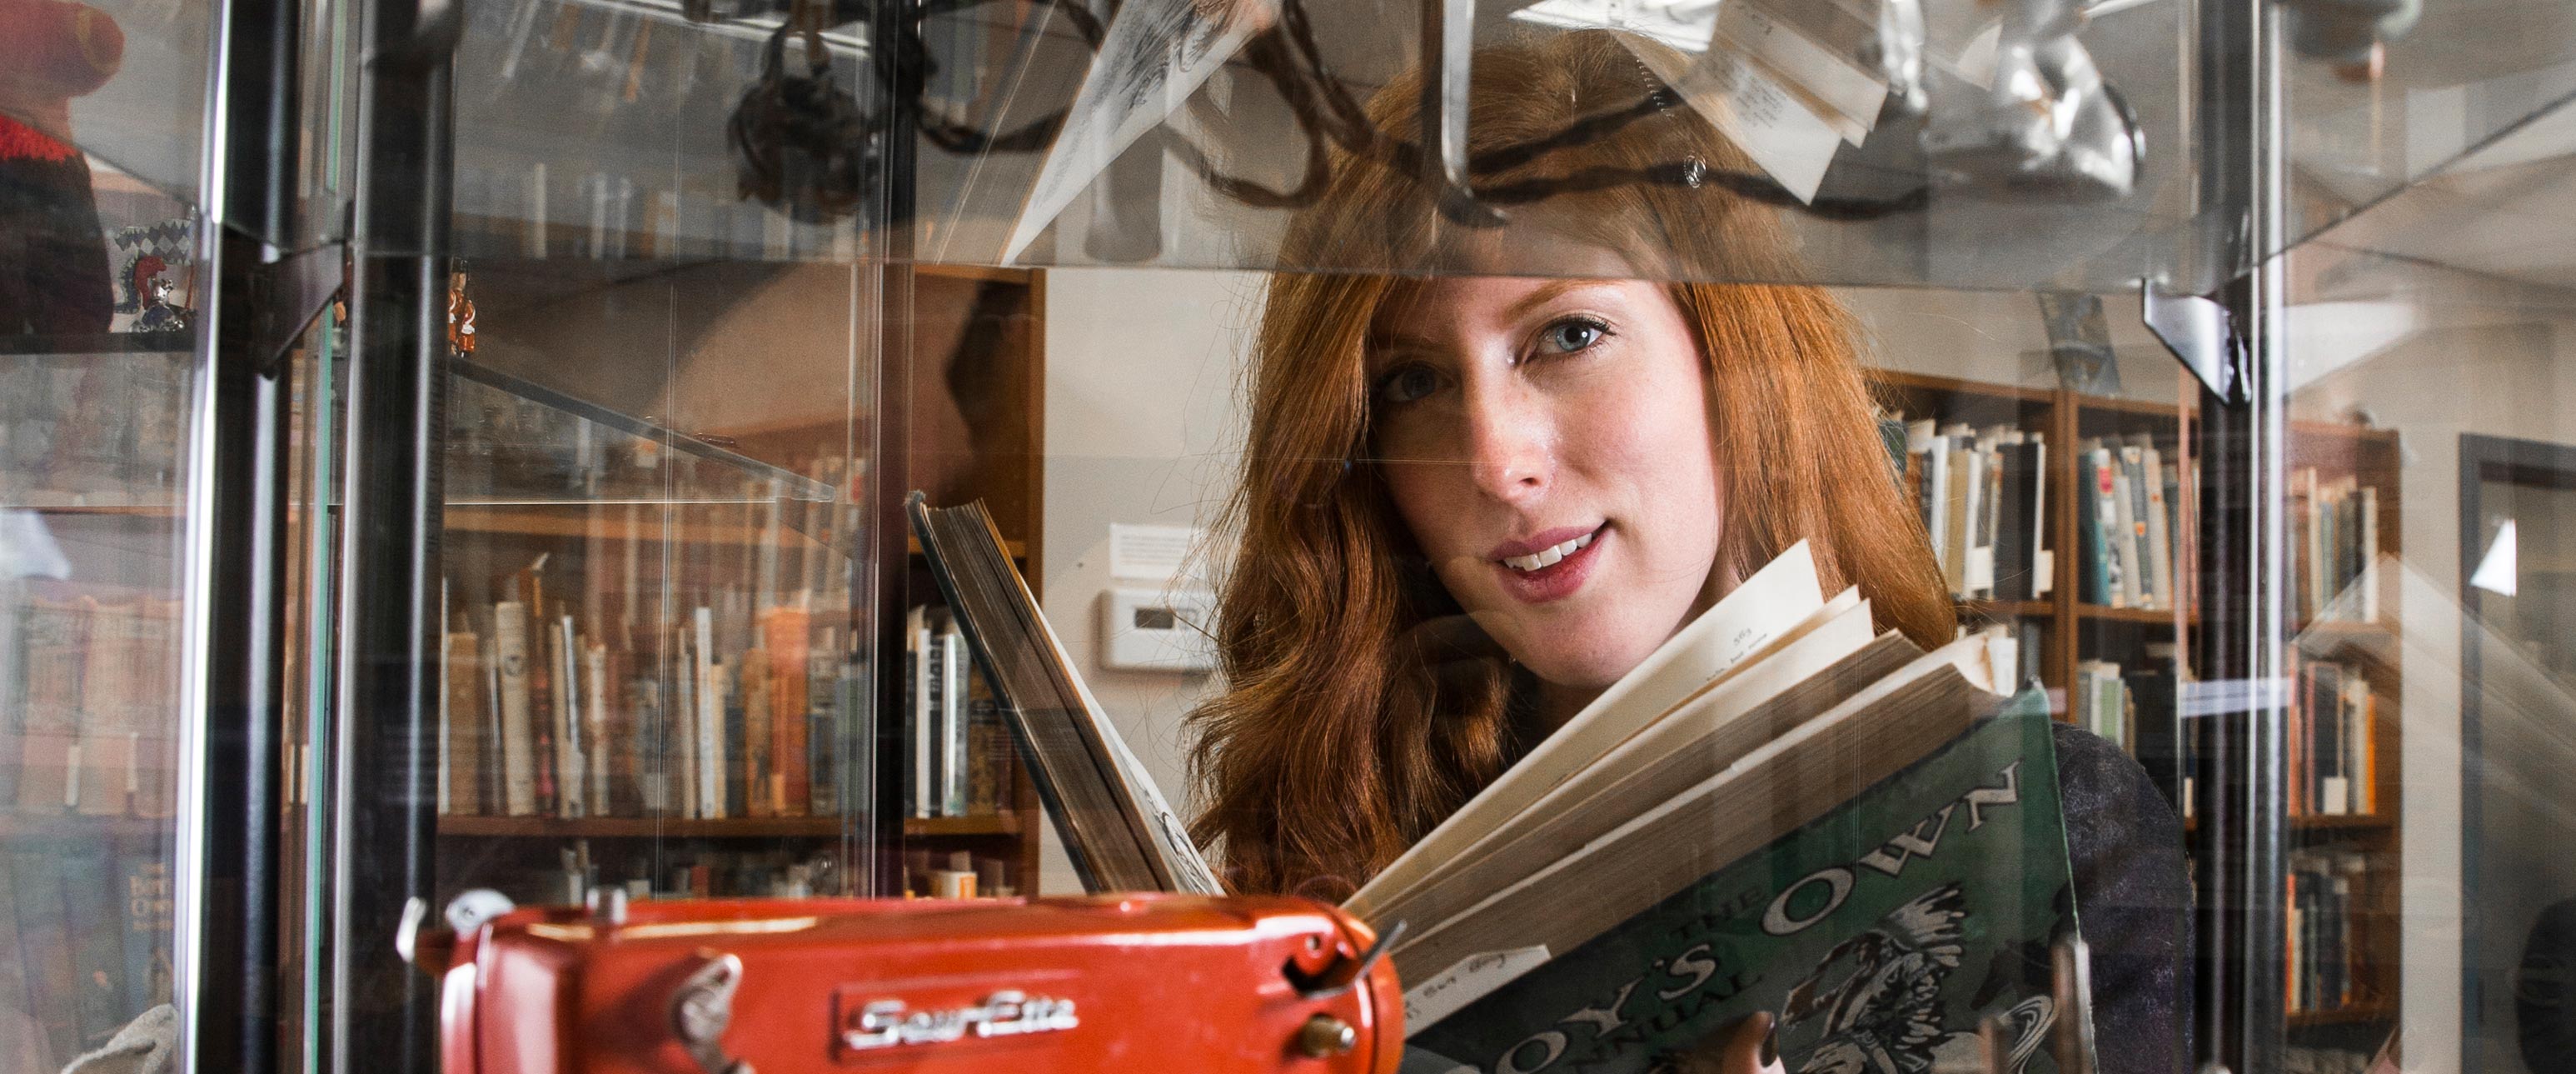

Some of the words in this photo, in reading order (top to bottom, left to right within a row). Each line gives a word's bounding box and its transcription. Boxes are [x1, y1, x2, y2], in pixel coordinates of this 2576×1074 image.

[1444, 942, 1717, 1074] OY'S
[1761, 757, 2024, 936] OWN
[1673, 888, 1765, 940] THE
[1566, 972, 1763, 1074] NNUAL
